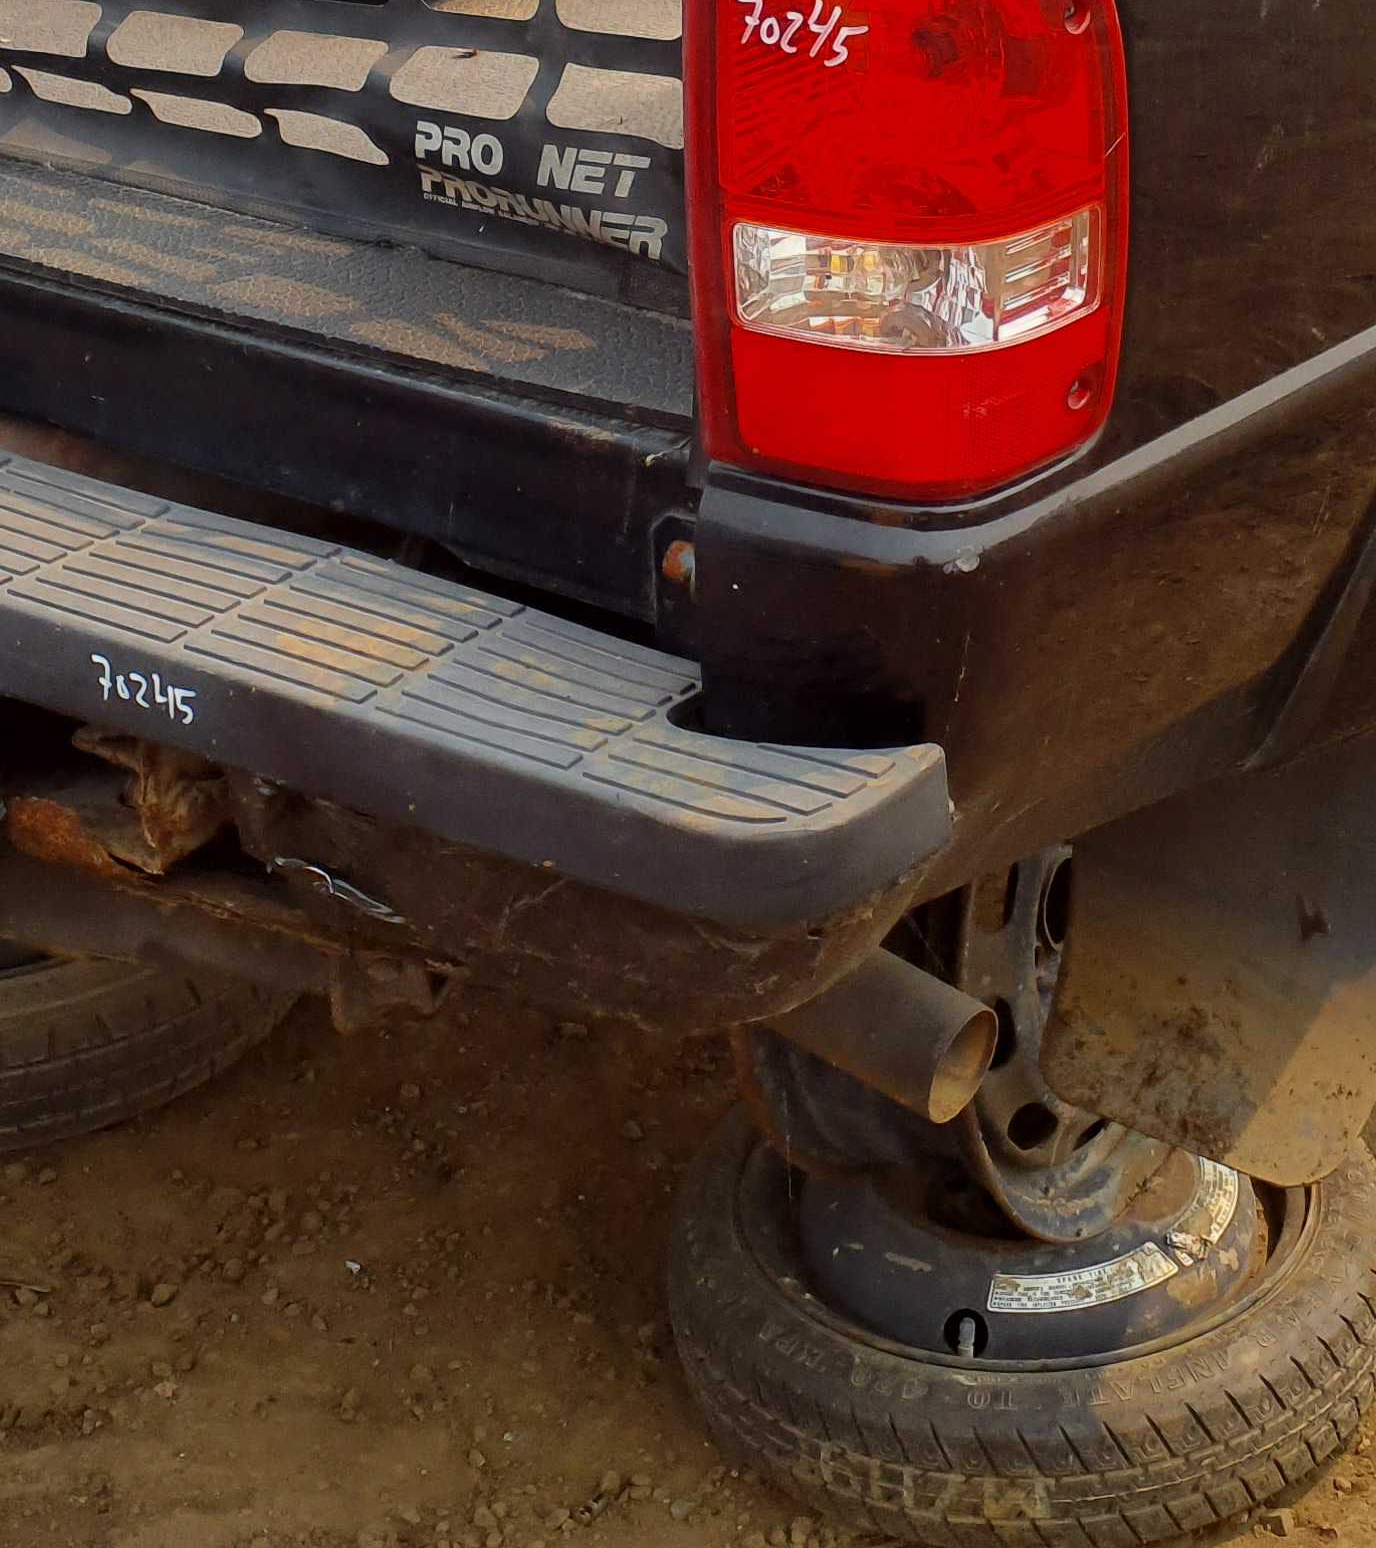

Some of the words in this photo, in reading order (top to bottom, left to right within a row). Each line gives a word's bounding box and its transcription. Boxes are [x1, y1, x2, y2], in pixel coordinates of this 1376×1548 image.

[414, 120, 504, 176] PRO
[536, 144, 652, 198] NET
[91, 653, 197, 725] 70245
